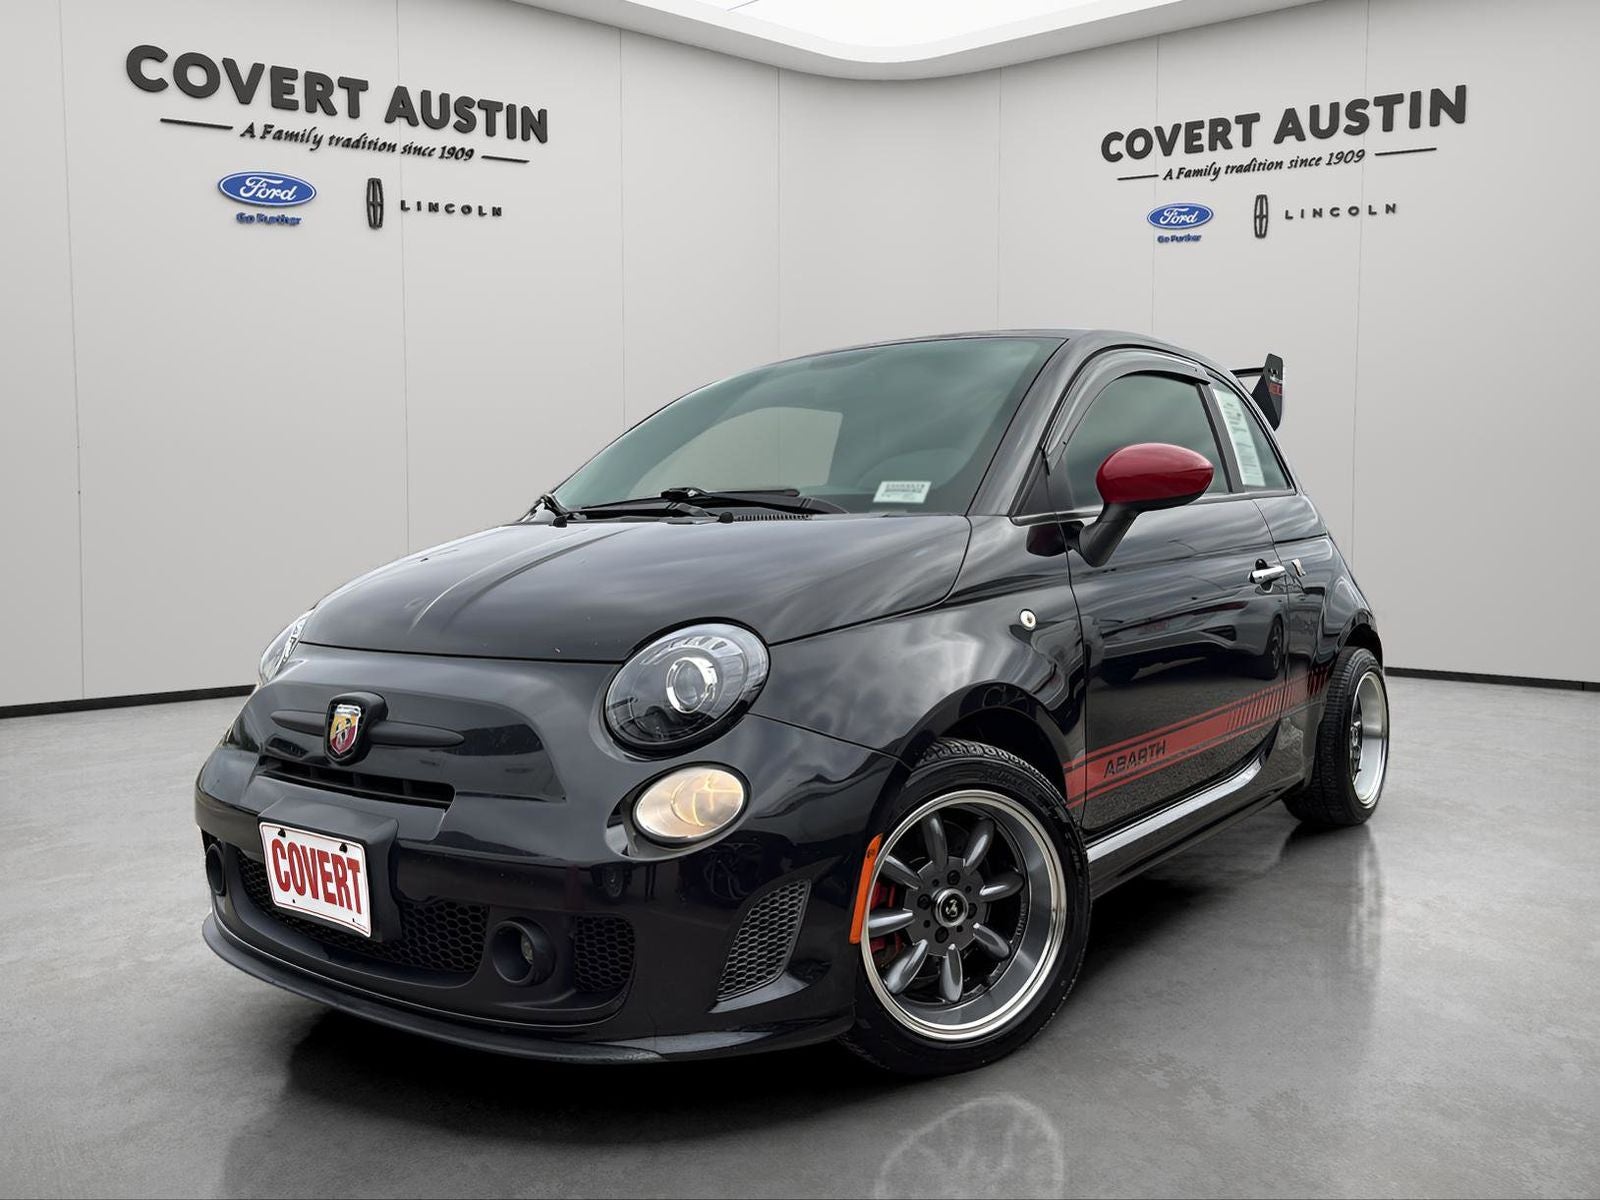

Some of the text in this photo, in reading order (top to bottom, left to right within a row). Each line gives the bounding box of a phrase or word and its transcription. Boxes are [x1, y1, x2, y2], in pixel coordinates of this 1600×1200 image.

[126, 44, 548, 145] COVERT AUSTIN
[239, 121, 475, 162] A Family tradition since 1909
[1100, 84, 1467, 163] COVERT AUSTIN
[1162, 149, 1365, 182] A Family tradition since 1909
[239, 176, 298, 201] Ford
[400, 199, 503, 218] LINCOLN
[1159, 207, 1199, 224] Ford
[1285, 203, 1397, 220] LINCOLN
[1103, 738, 1166, 778] ABARTH
[271, 838, 362, 915] COVERT
